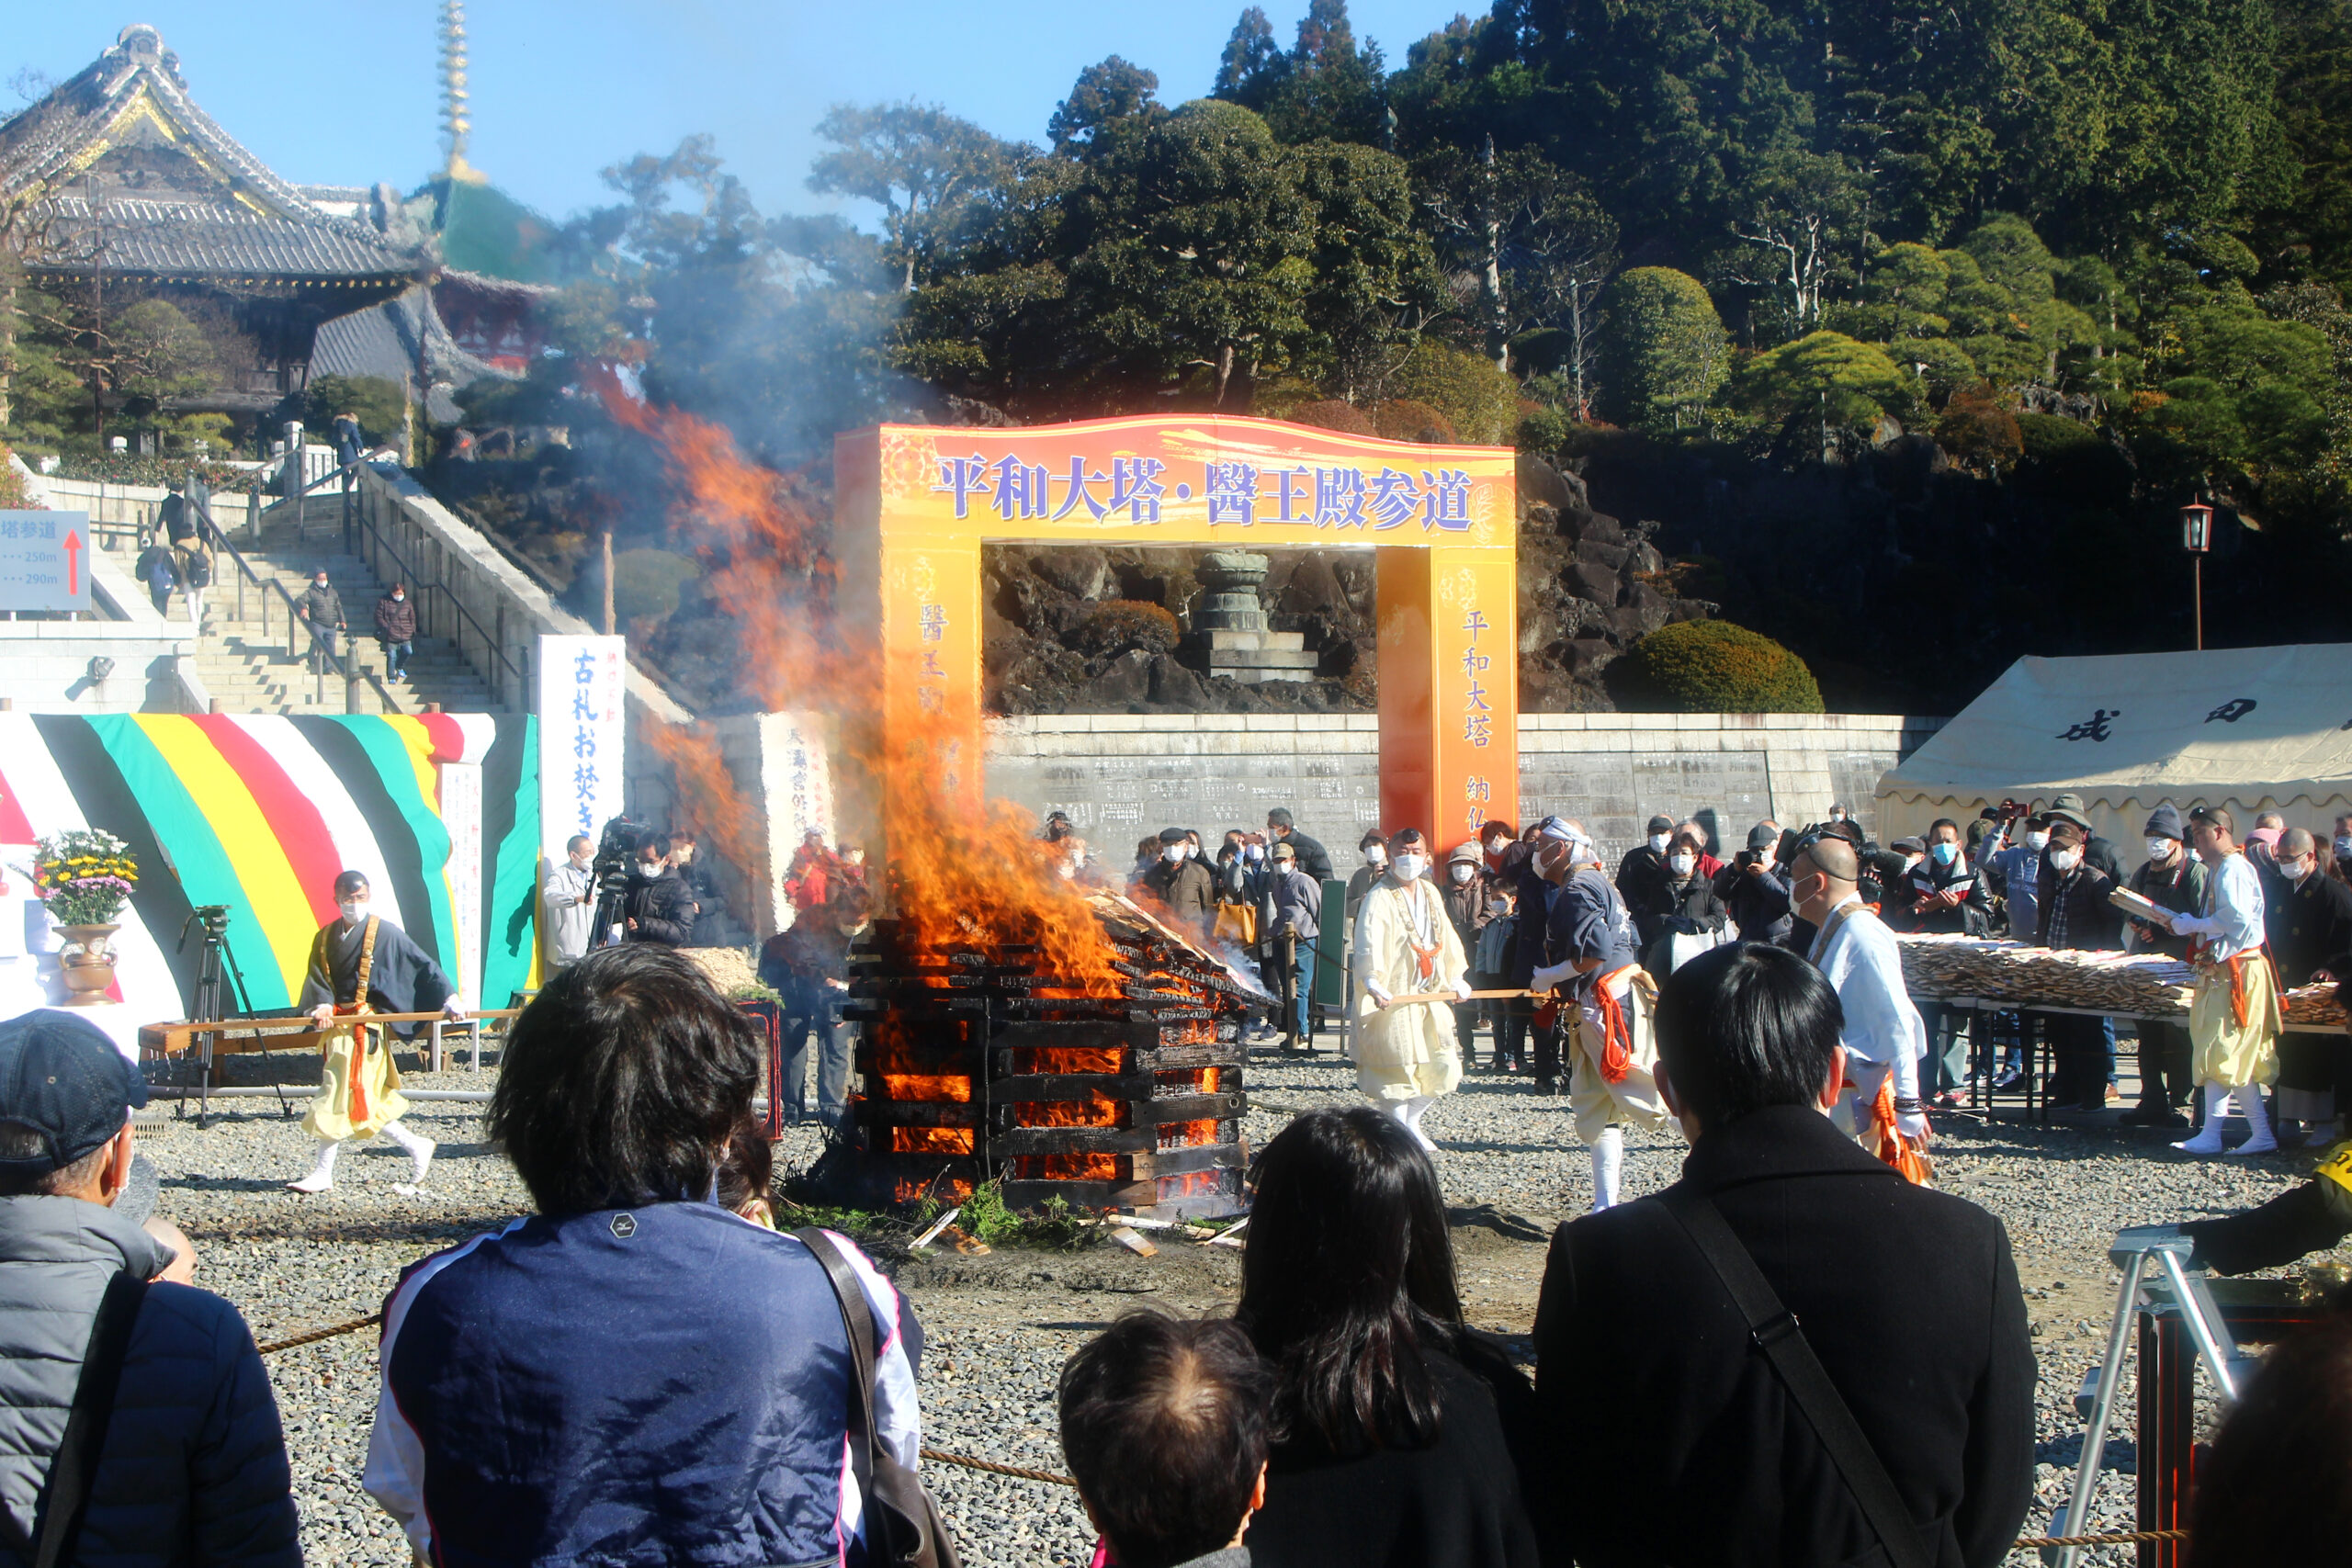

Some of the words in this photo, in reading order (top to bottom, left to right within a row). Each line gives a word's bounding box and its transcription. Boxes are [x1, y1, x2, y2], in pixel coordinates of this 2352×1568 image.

[931, 451, 1473, 532] 平和大塔・醫王殿参道
[0, 520, 57, 539] 塔参道
[1462, 610, 1491, 748] 平和大塔
[1465, 776, 1490, 842] 納仏
